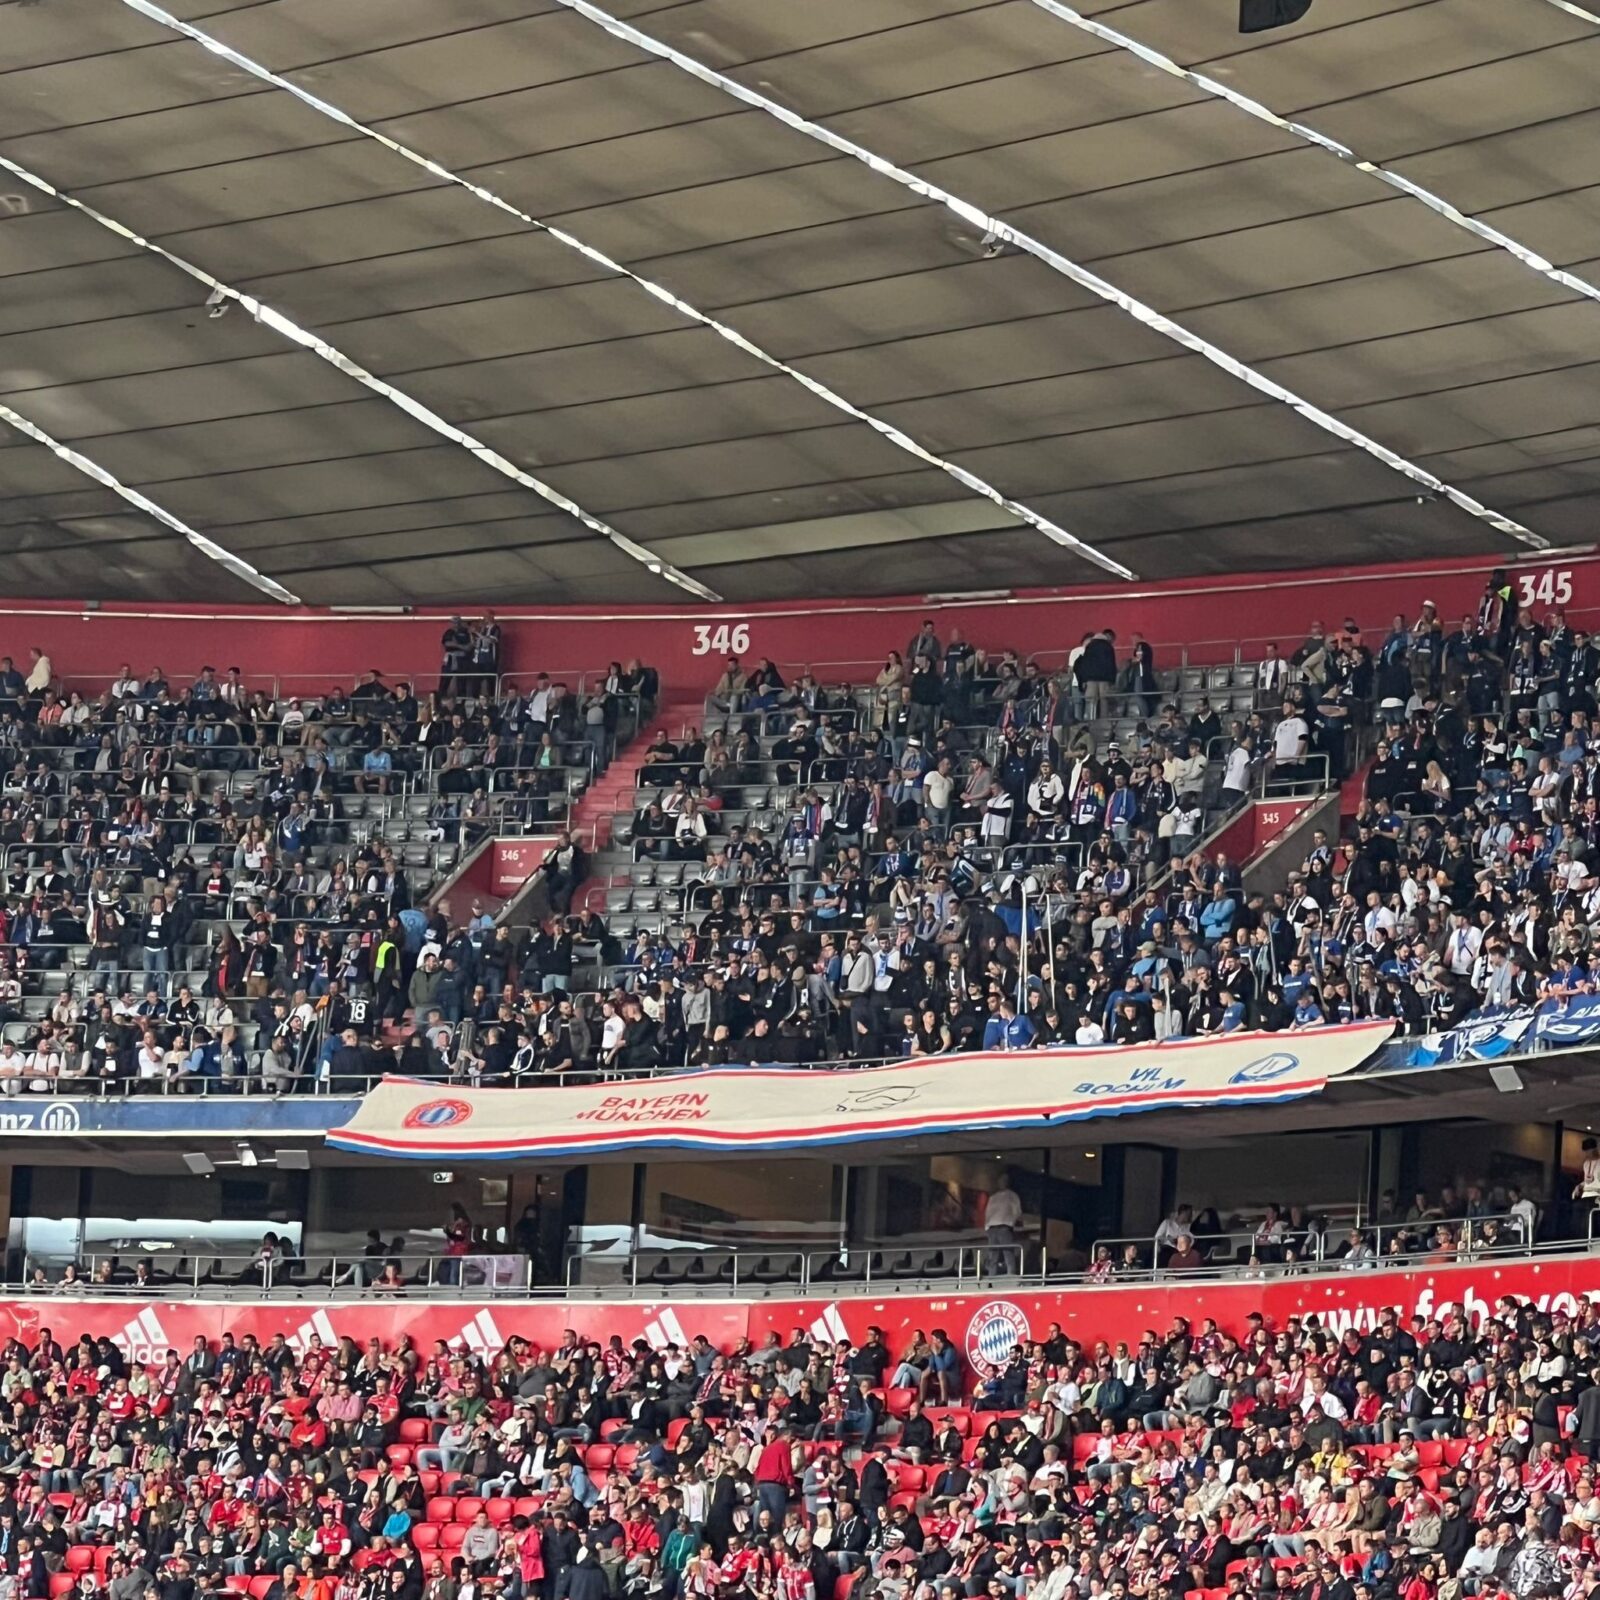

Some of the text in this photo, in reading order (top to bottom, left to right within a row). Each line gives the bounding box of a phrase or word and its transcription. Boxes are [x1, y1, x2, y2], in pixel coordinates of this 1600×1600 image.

[1519, 570, 1572, 607] 345
[692, 624, 750, 655] 346
[1262, 812, 1280, 824] 345
[501, 850, 520, 861] 346
[350, 1002, 366, 1021] 18
[600, 1094, 709, 1109] BAYERN
[118, 1343, 181, 1365] dida
